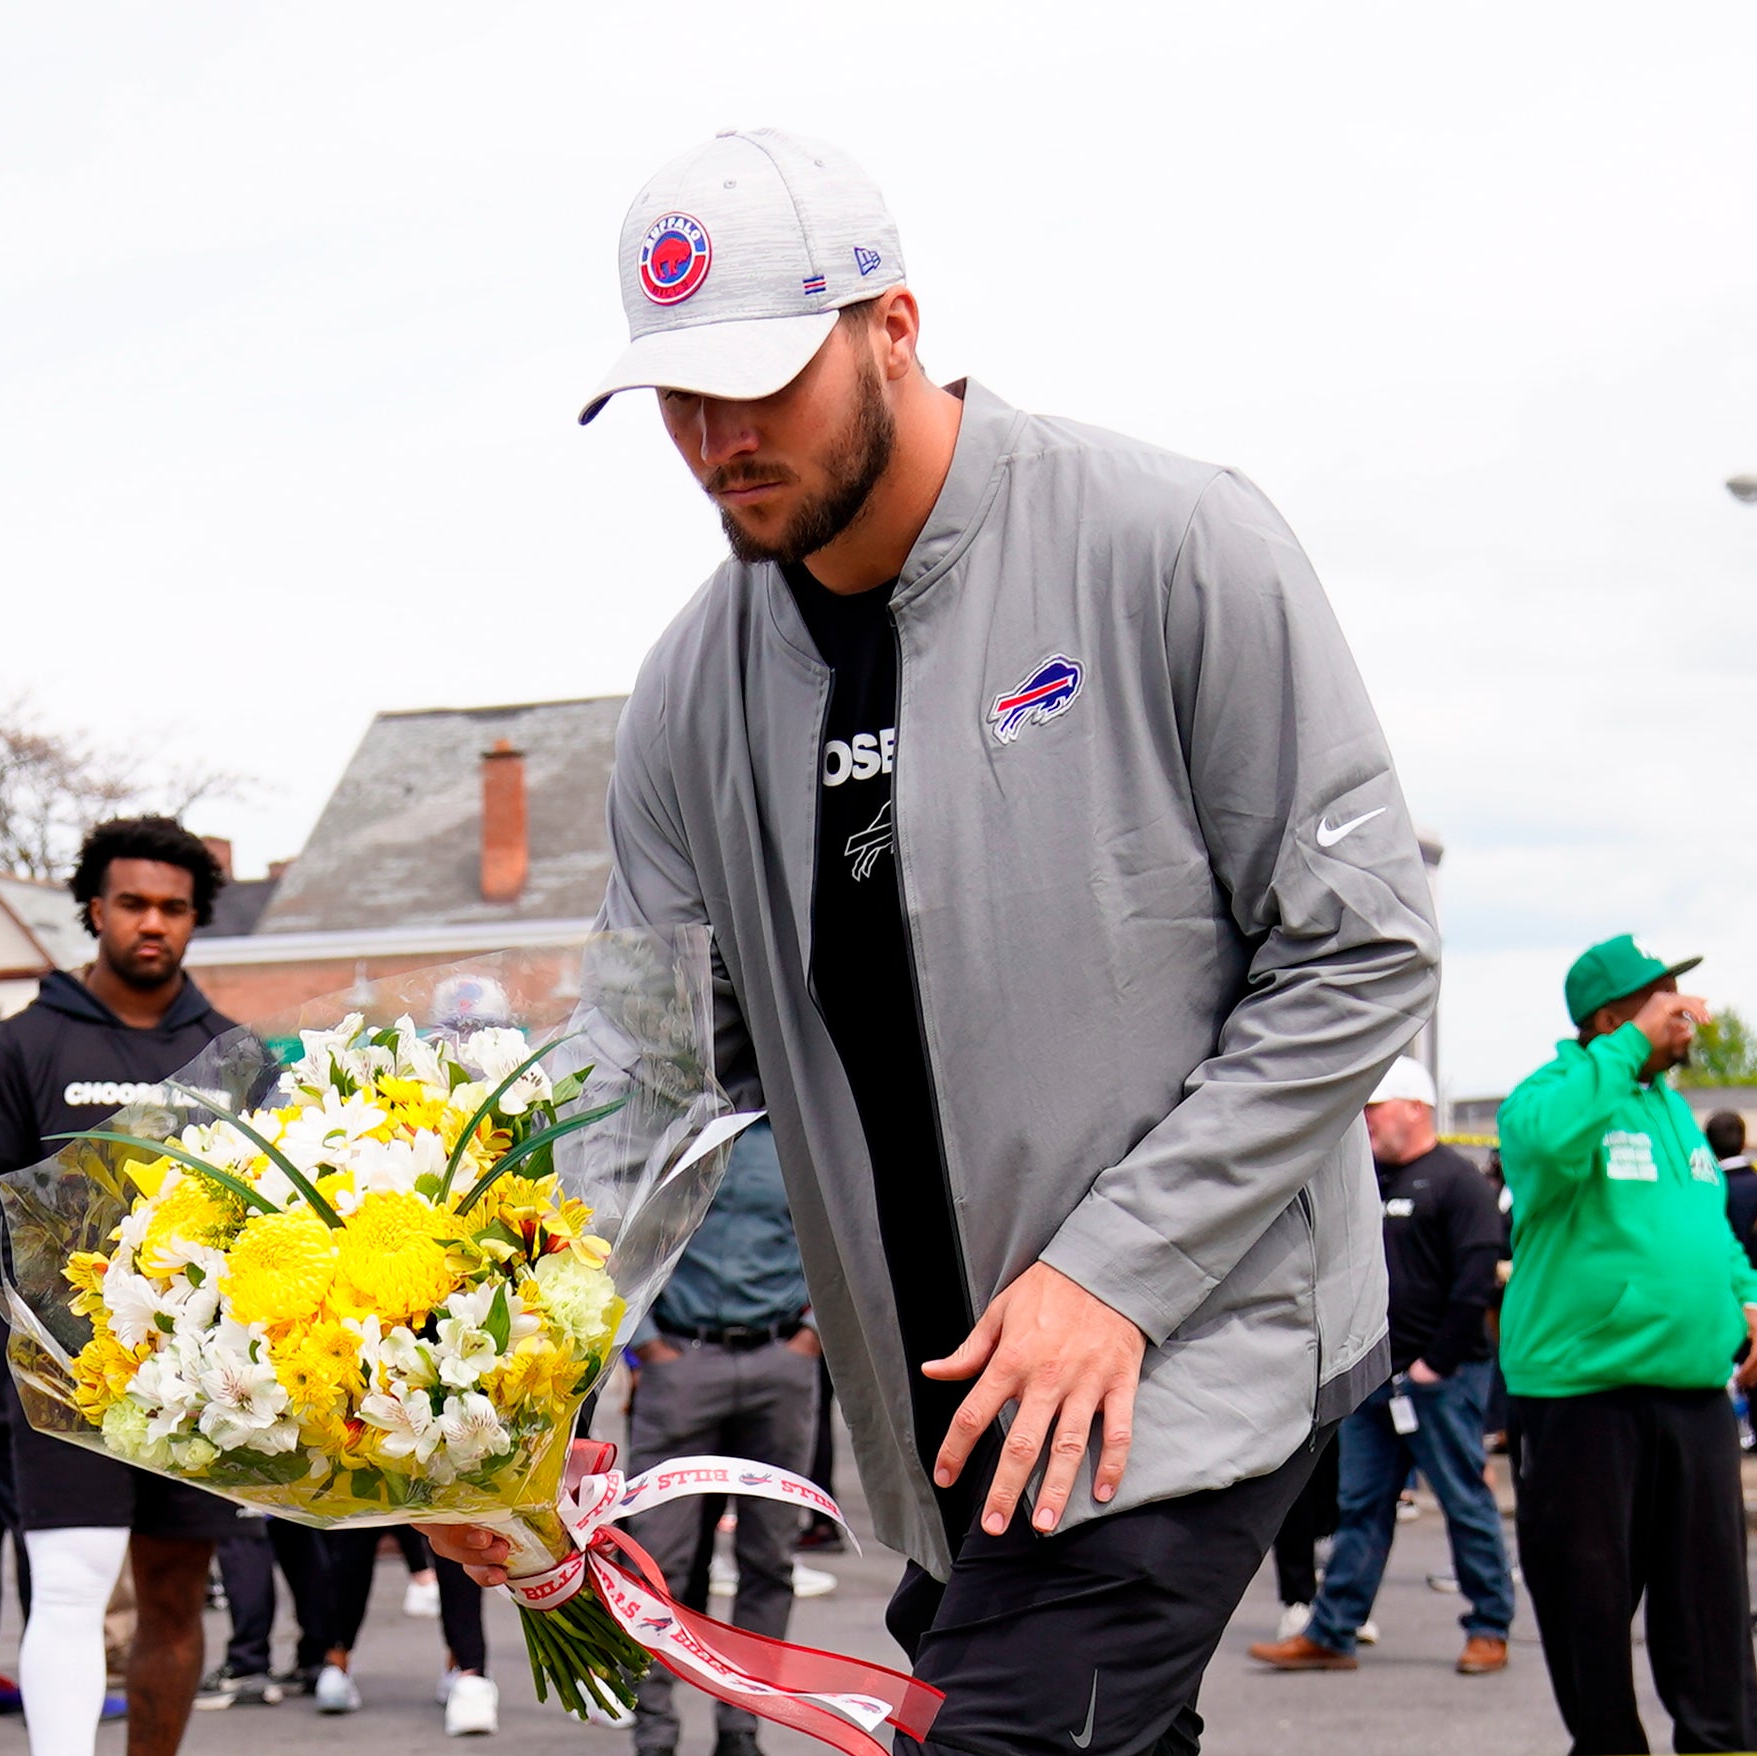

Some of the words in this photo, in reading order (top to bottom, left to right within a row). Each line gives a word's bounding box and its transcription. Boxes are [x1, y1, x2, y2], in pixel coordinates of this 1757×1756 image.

[645, 216, 702, 249] BUFFALO
[63, 1081, 169, 1107] CHOOSE
[657, 1469, 730, 1491] BILLS
[575, 1473, 620, 1531] BILLS
[669, 1627, 732, 1676] BILLS
